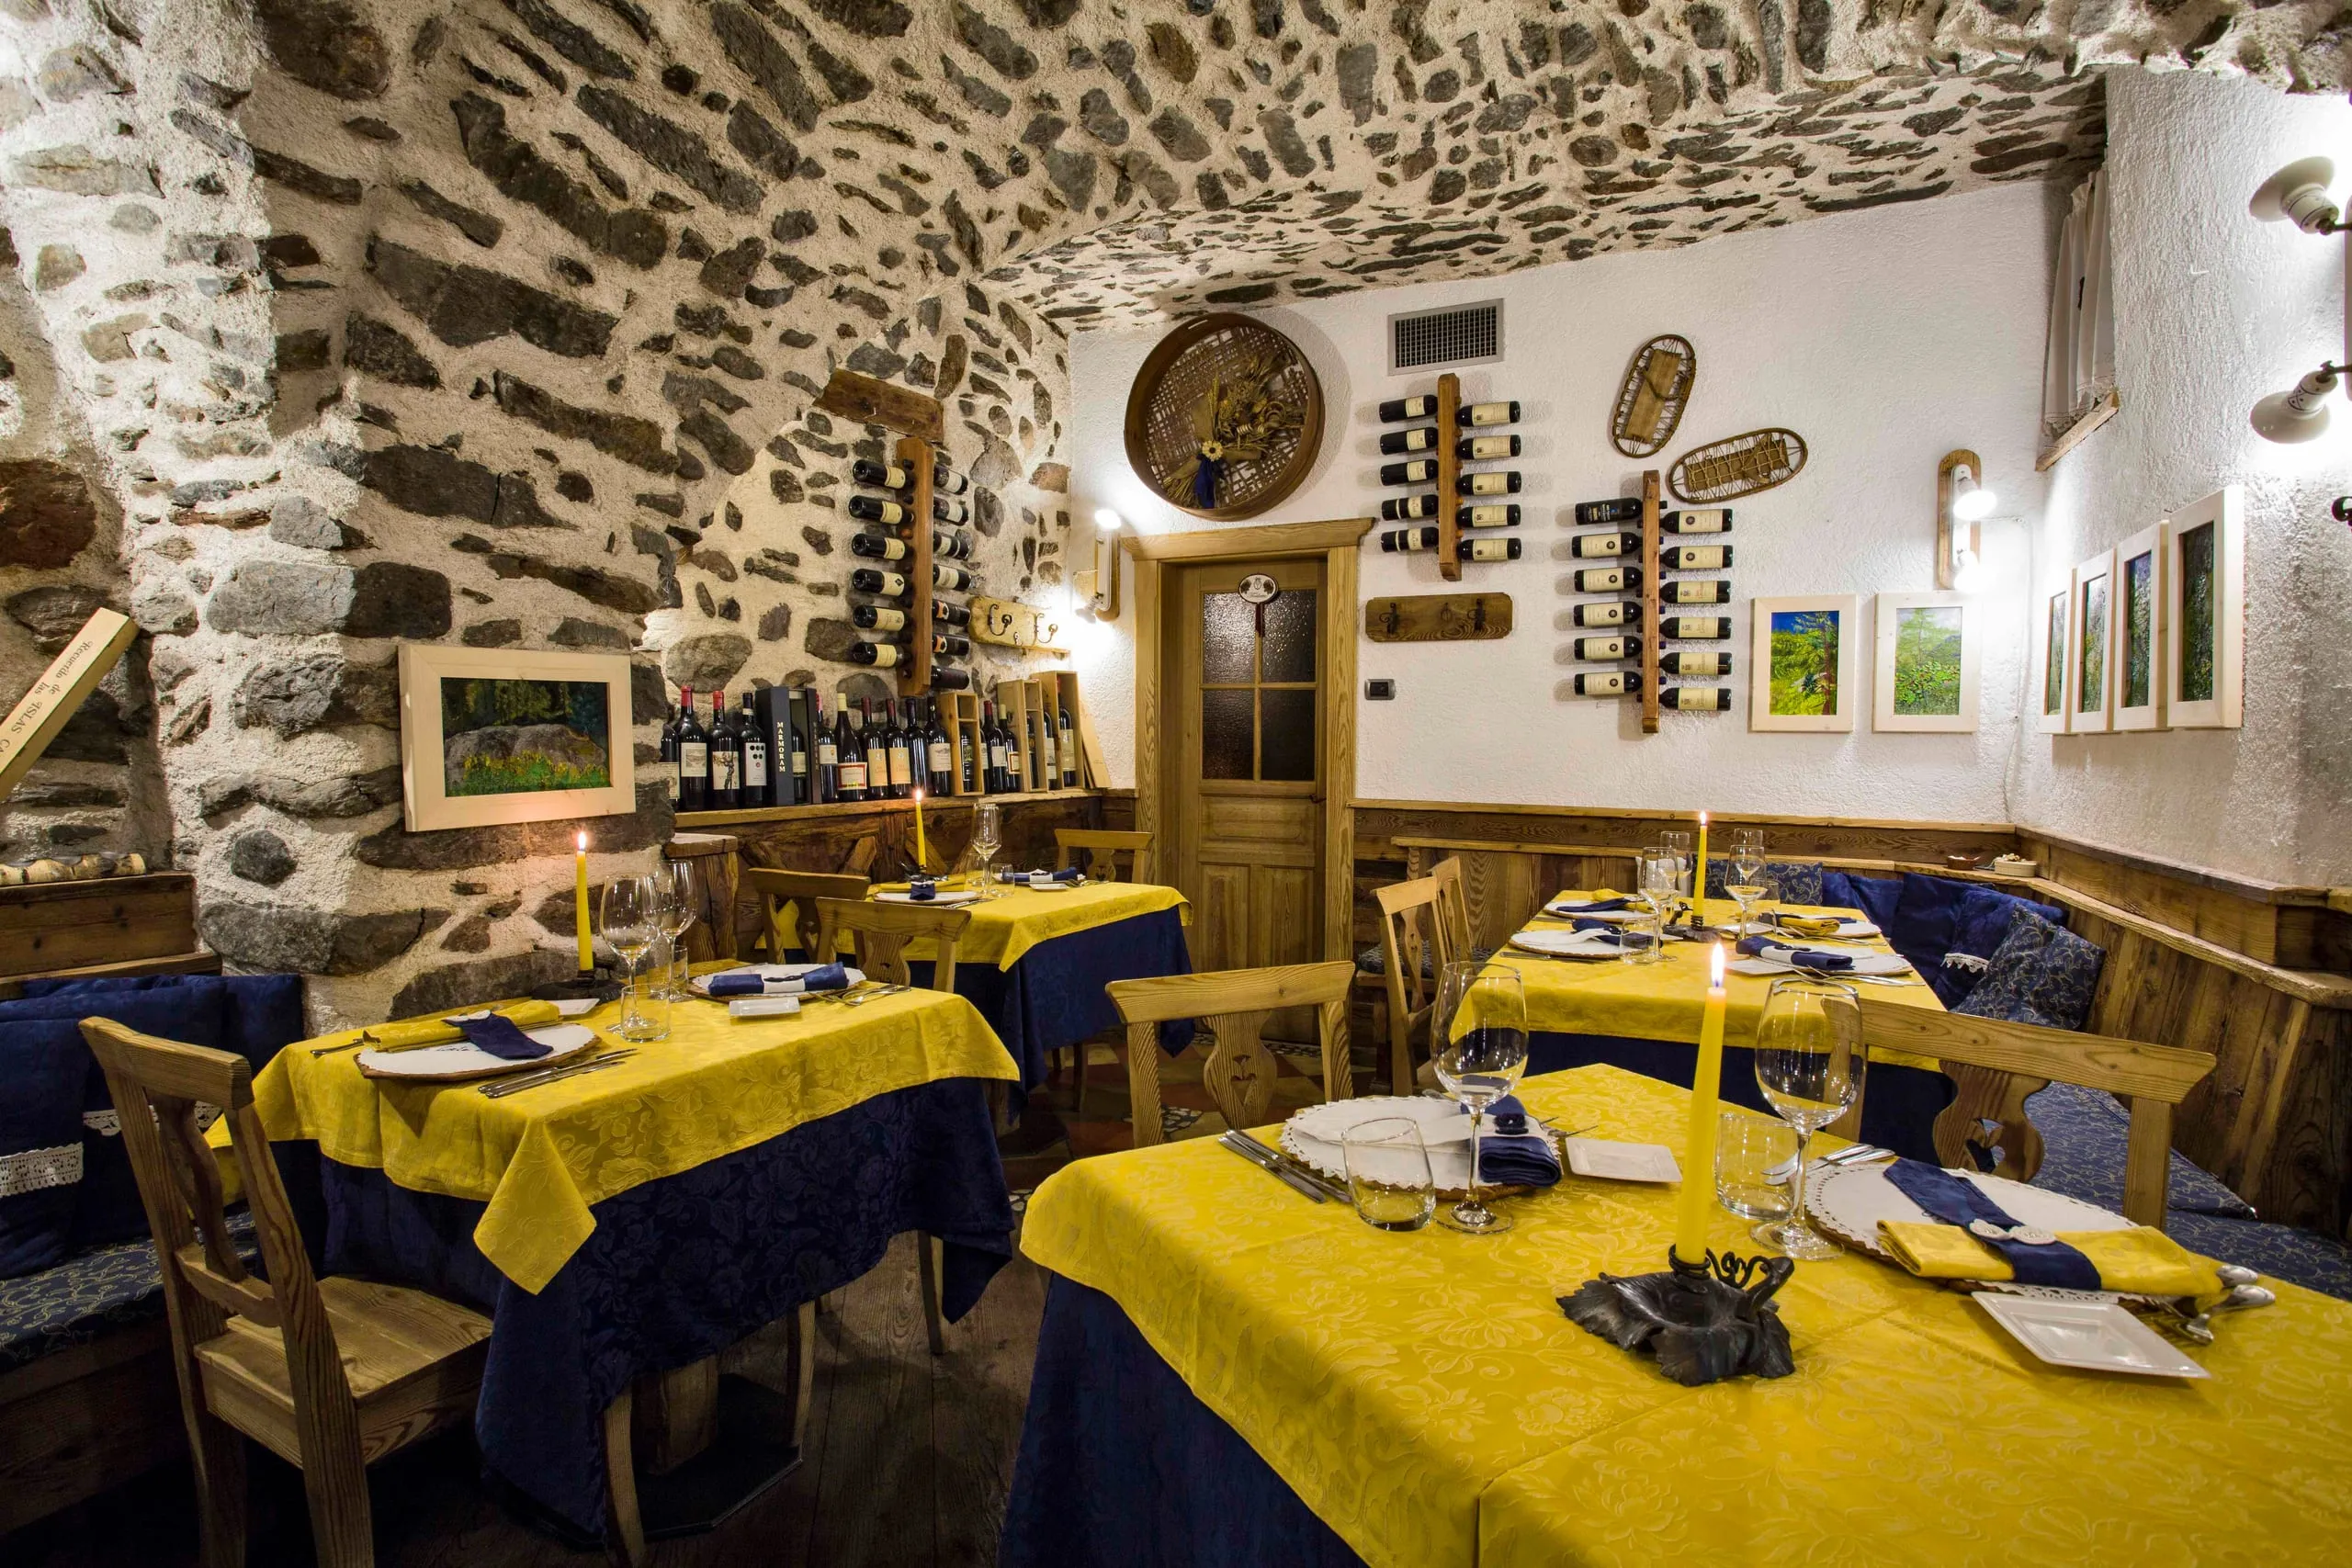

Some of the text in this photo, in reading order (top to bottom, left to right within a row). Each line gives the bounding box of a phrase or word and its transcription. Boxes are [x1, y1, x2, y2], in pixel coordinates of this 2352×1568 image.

[55, 640, 93, 679] Recuerdo
[34, 682, 51, 694] las
[49, 683, 61, 695] de
[11, 701, 43, 734] ISLAS
[776, 721, 786, 773] MARMORAM
